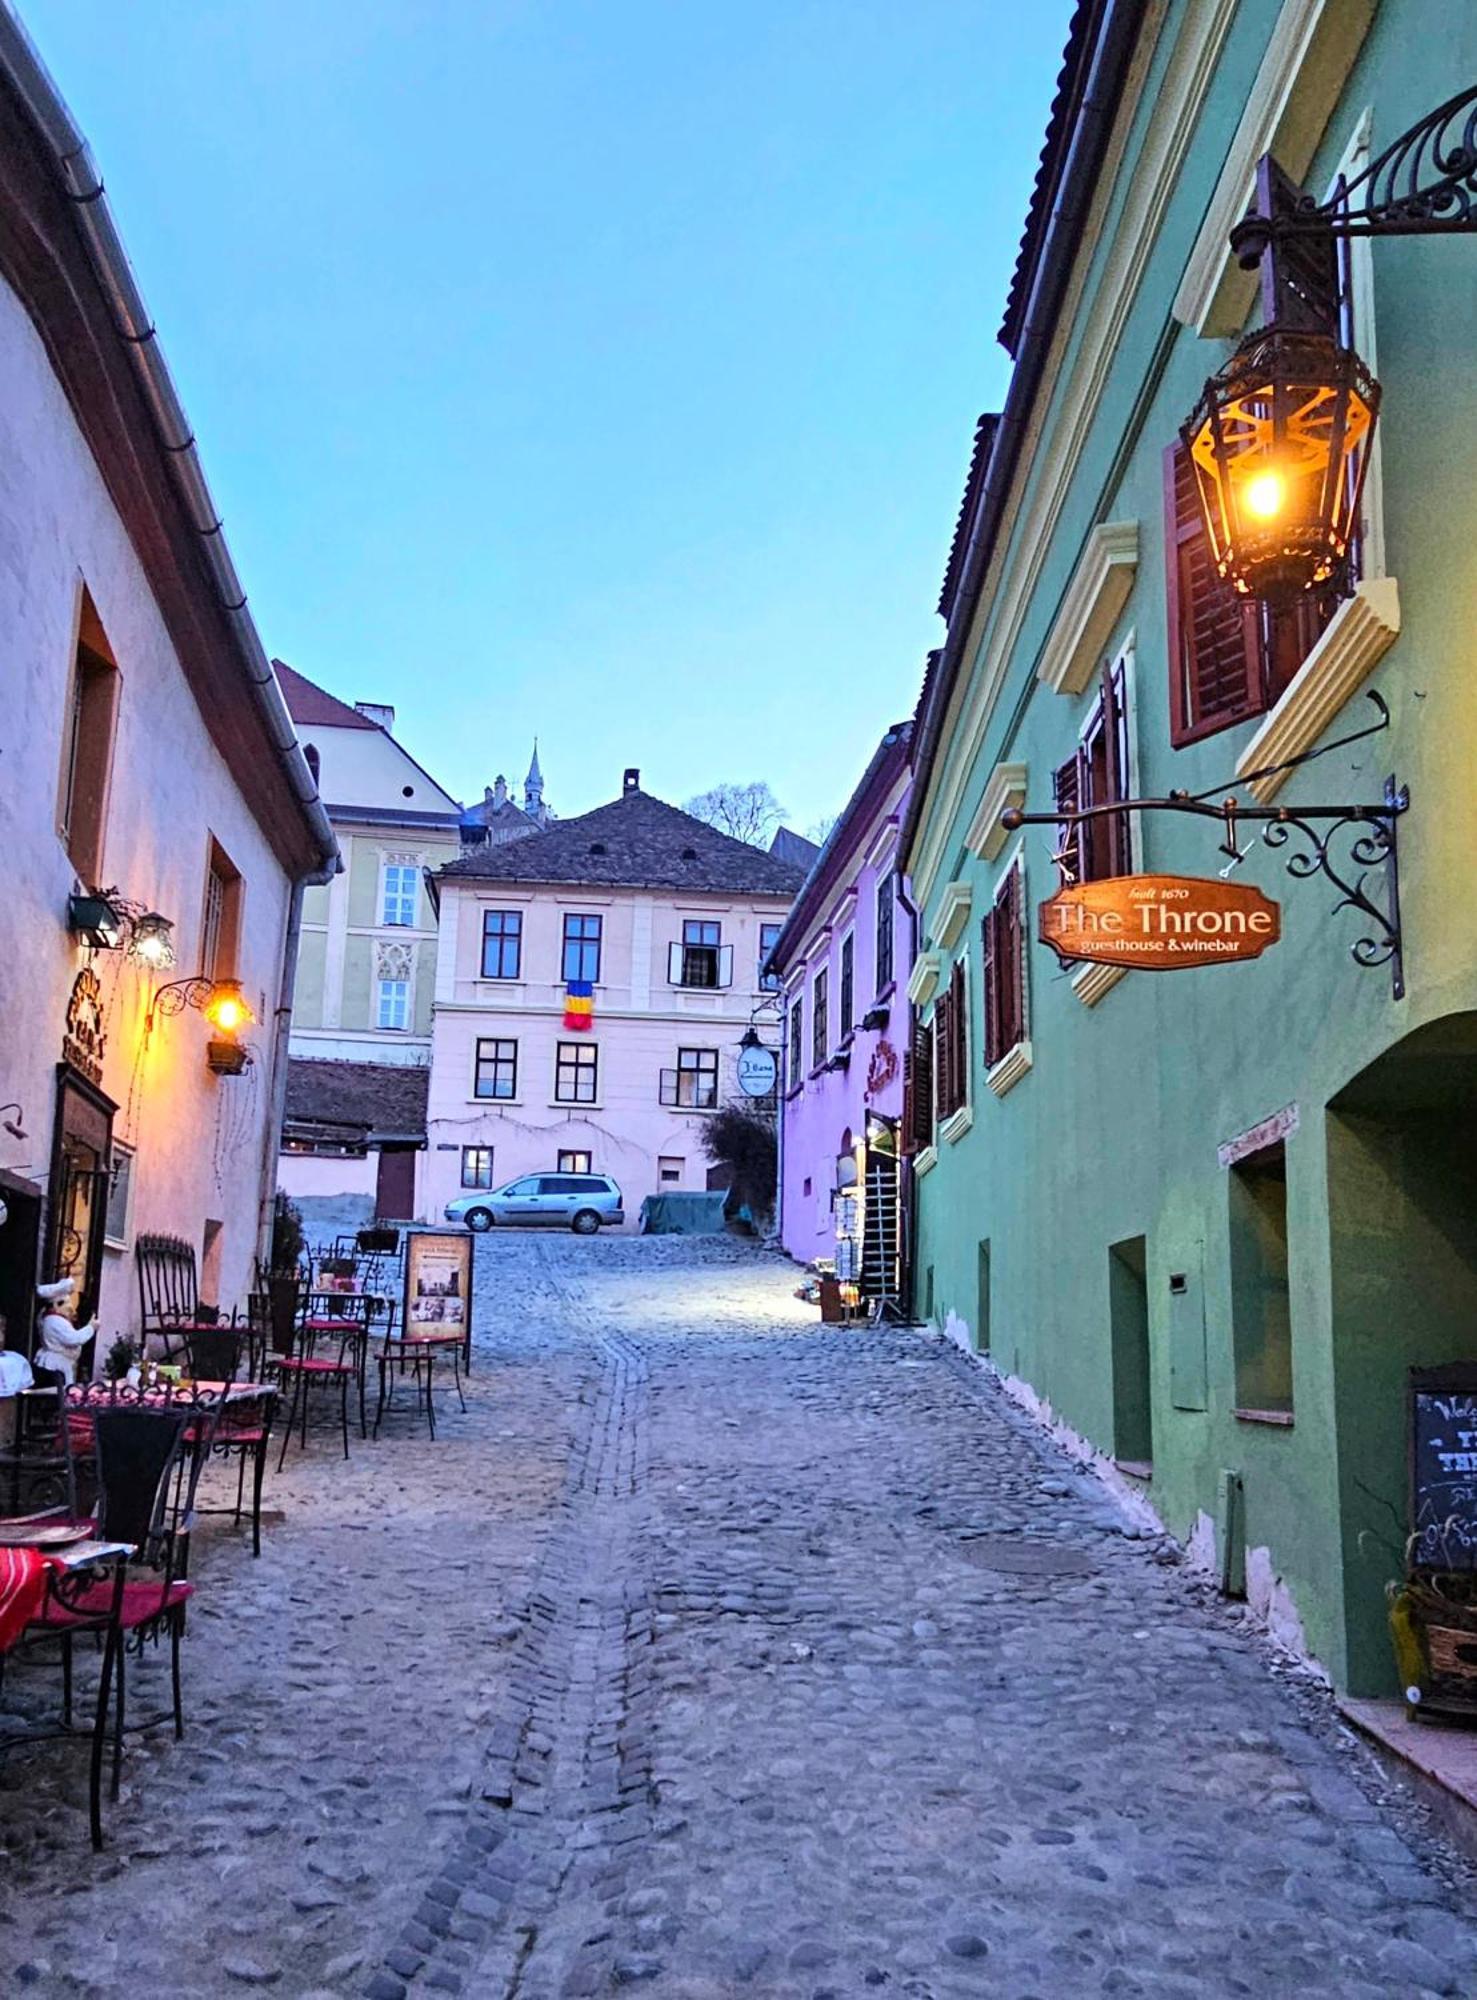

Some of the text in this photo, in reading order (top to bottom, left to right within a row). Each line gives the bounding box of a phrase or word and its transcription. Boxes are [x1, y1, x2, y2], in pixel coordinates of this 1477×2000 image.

[1128, 887, 1190, 900] built 1670
[1052, 904, 1272, 934] The Throne
[1080, 938, 1165, 954] guesthouse
